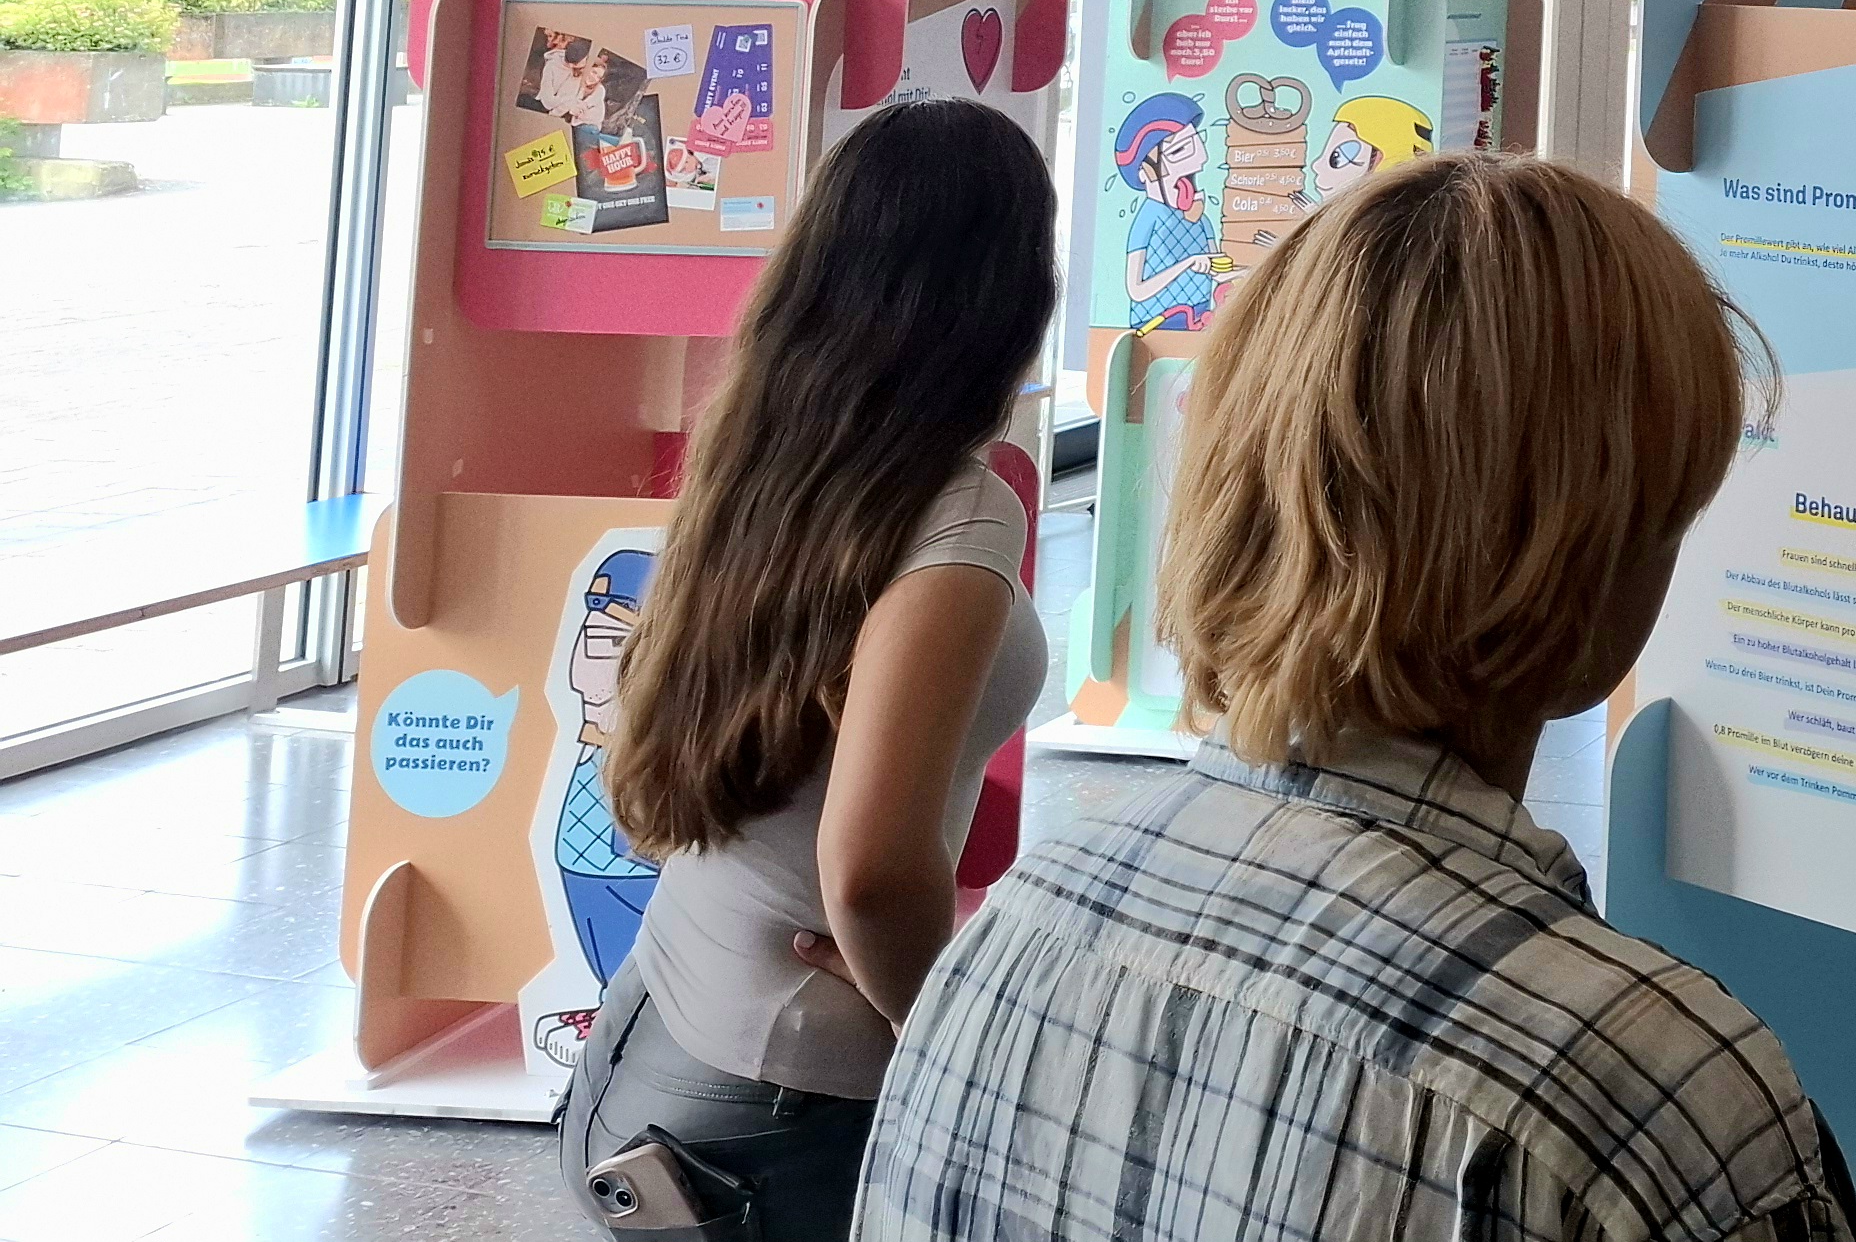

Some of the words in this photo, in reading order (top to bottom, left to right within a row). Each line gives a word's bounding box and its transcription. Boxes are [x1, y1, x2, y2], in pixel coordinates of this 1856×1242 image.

[1279, 5, 1309, 14] locker,
[1310, 5, 1327, 14] das
[1280, 15, 1309, 23] haben
[1311, 15, 1325, 23] wir
[1286, 24, 1317, 33] gleich.
[1334, 29, 1369, 38] einfach
[1352, 39, 1373, 47] dem
[602, 146, 632, 166] HAPPY
[1234, 150, 1256, 162] Bier
[607, 157, 634, 174] HOUR
[1230, 173, 1265, 186] Schorle
[1723, 177, 1761, 201] Was
[1765, 182, 1807, 205] sind
[1232, 196, 1258, 211] Cola
[1781, 254, 1792, 264] Du
[1782, 549, 1809, 563] Frauen
[1810, 554, 1828, 566] sind
[1725, 569, 1739, 580] Der
[1740, 572, 1766, 586] Abbau
[1767, 577, 1781, 589] des
[1783, 581, 1831, 600] Blutalkohols
[1727, 601, 1741, 612] Der
[1742, 605, 1790, 624] menschliche
[1791, 615, 1818, 629] Körper
[1820, 619, 1840, 633] kann
[1841, 626, 1856, 637] pro
[1757, 639, 1781, 653] hoher
[1729, 664, 1740, 675] Du
[1758, 671, 1774, 683] Bier
[1816, 684, 1835, 698] Dein
[387, 711, 461, 730] Könnte
[465, 715, 495, 731] Dir
[1788, 709, 1805, 722] Wer
[1836, 721, 1856, 734] baut
[394, 733, 430, 749] das
[434, 736, 484, 751] auch
[1773, 738, 1789, 751] Blut
[385, 754, 491, 773] passieren?
